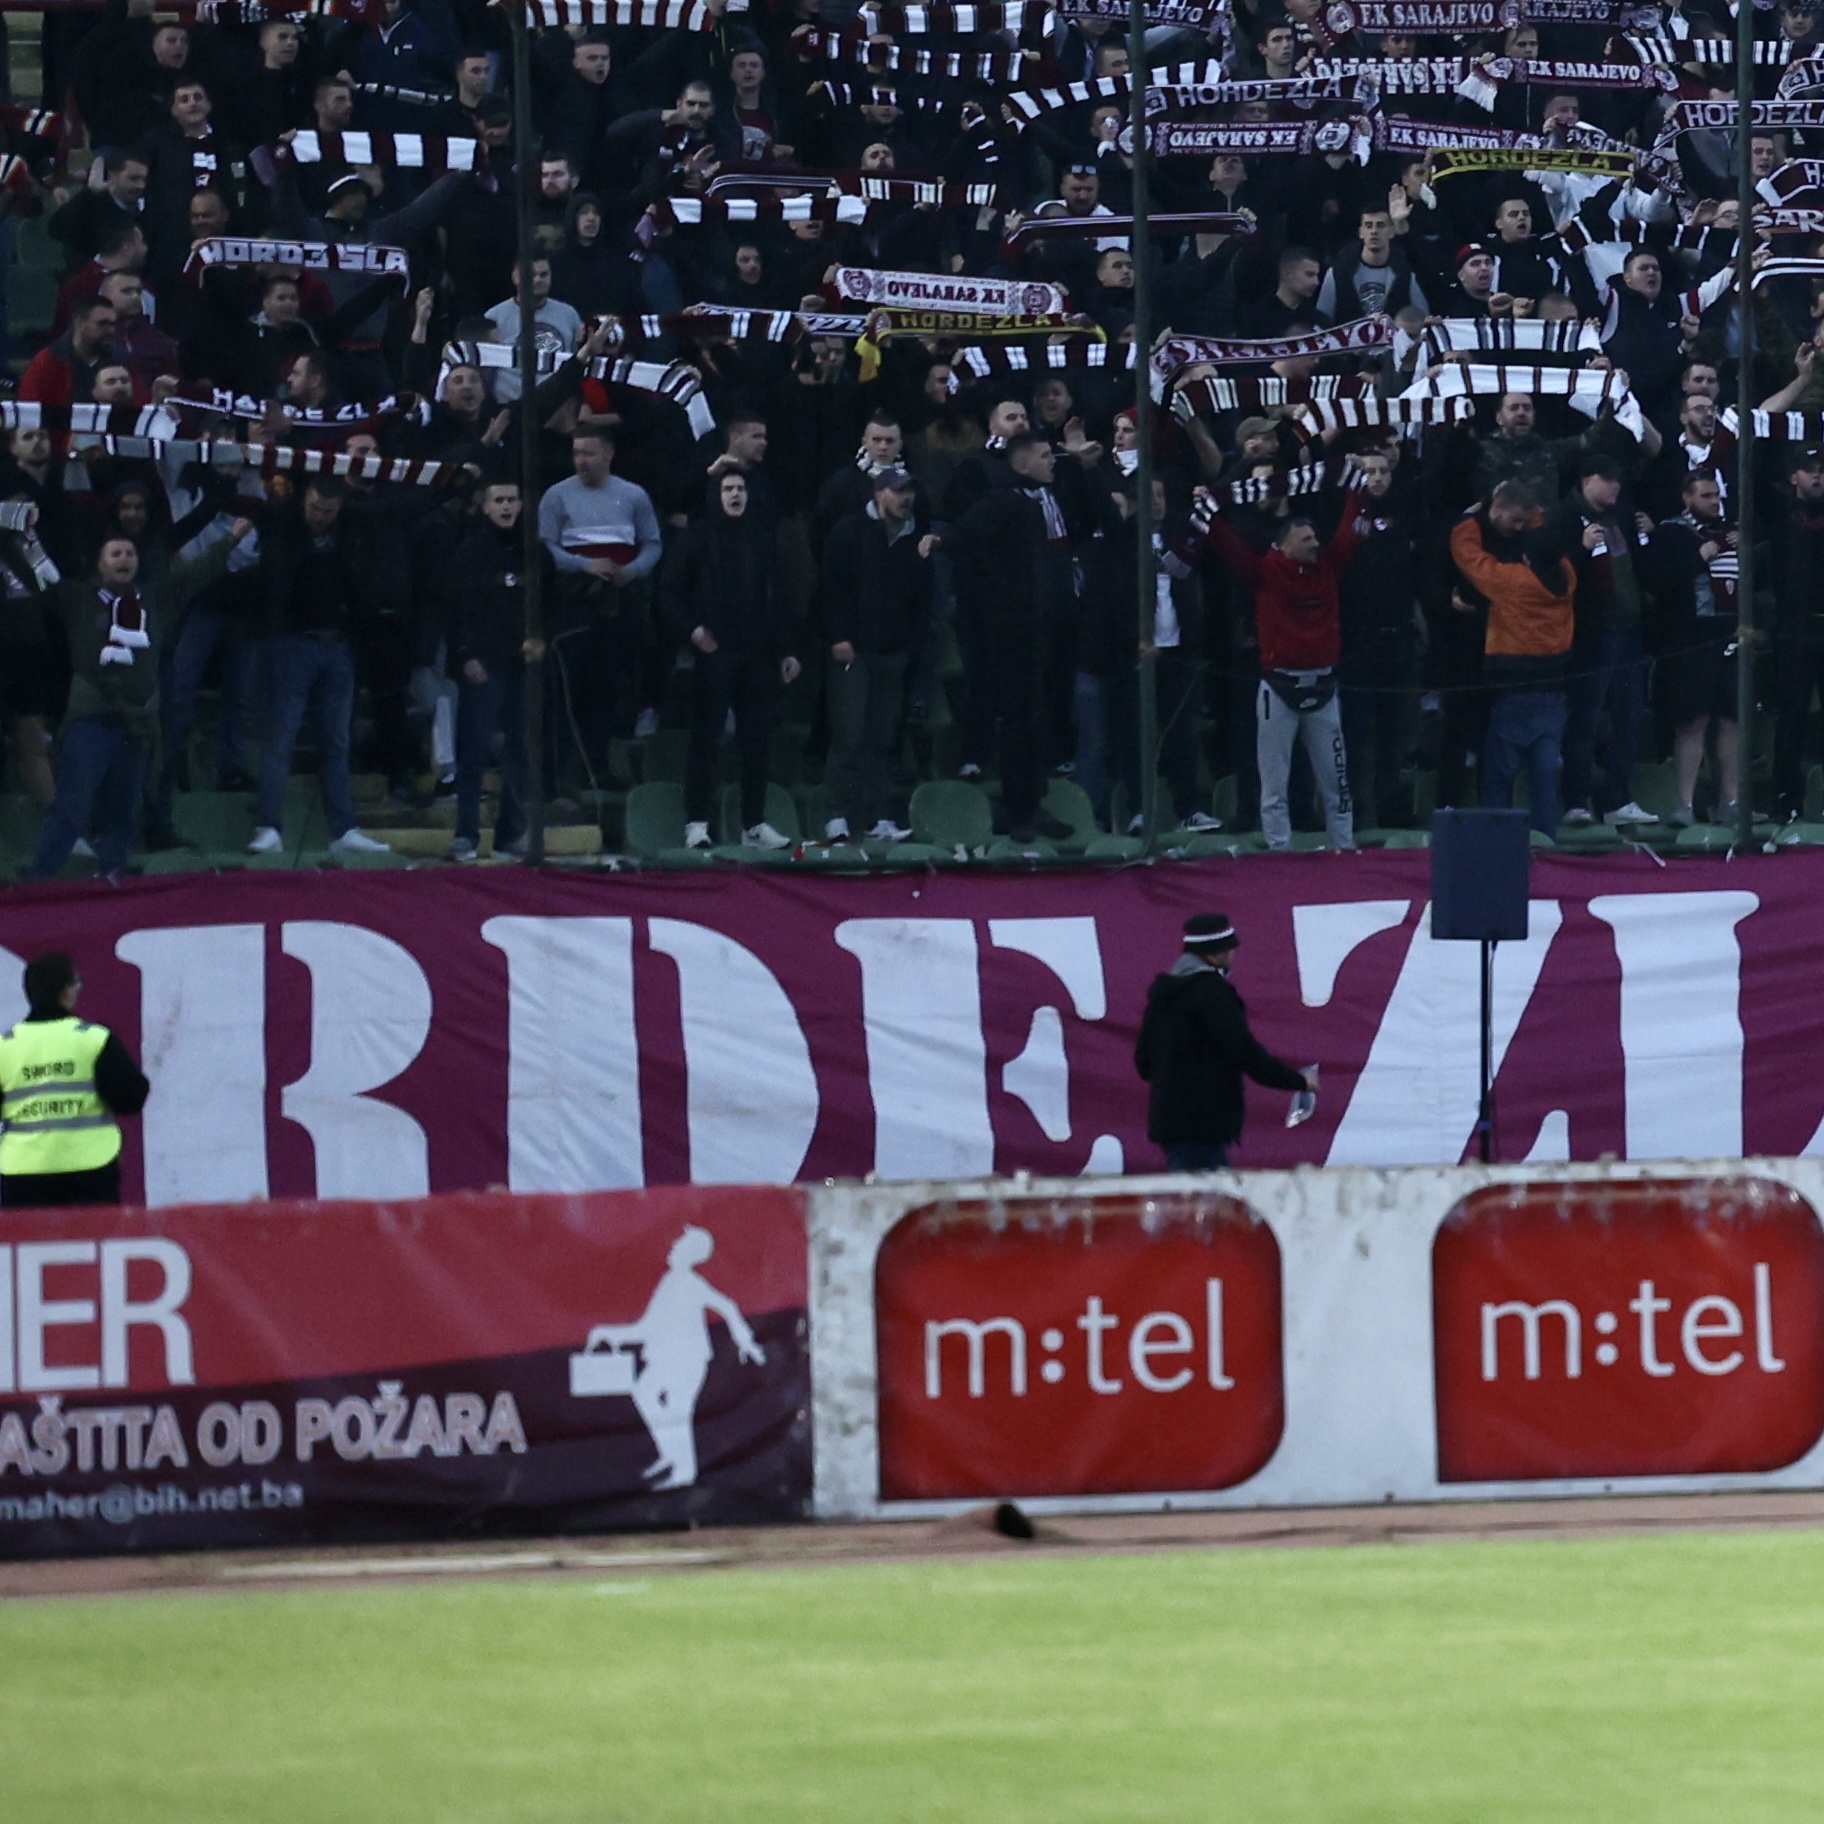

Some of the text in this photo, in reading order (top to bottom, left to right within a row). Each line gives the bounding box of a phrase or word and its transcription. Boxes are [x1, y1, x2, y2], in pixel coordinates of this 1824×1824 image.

[1392, 2, 1496, 25] SARAJEVO
[1554, 62, 1640, 82] SARAJEVO
[1170, 124, 1268, 151] SARAJEVO
[1420, 128, 1499, 149] SARAJEVO
[1445, 150, 1610, 169] HORDEZLA
[0, 916, 1122, 1208] RDE
[0, 1236, 196, 1393] ER
[924, 1278, 1234, 1399] m:tel
[1481, 1263, 1785, 1382] m:tel
[197, 1402, 284, 1467] OD
[295, 1380, 527, 1463] POŽARA
